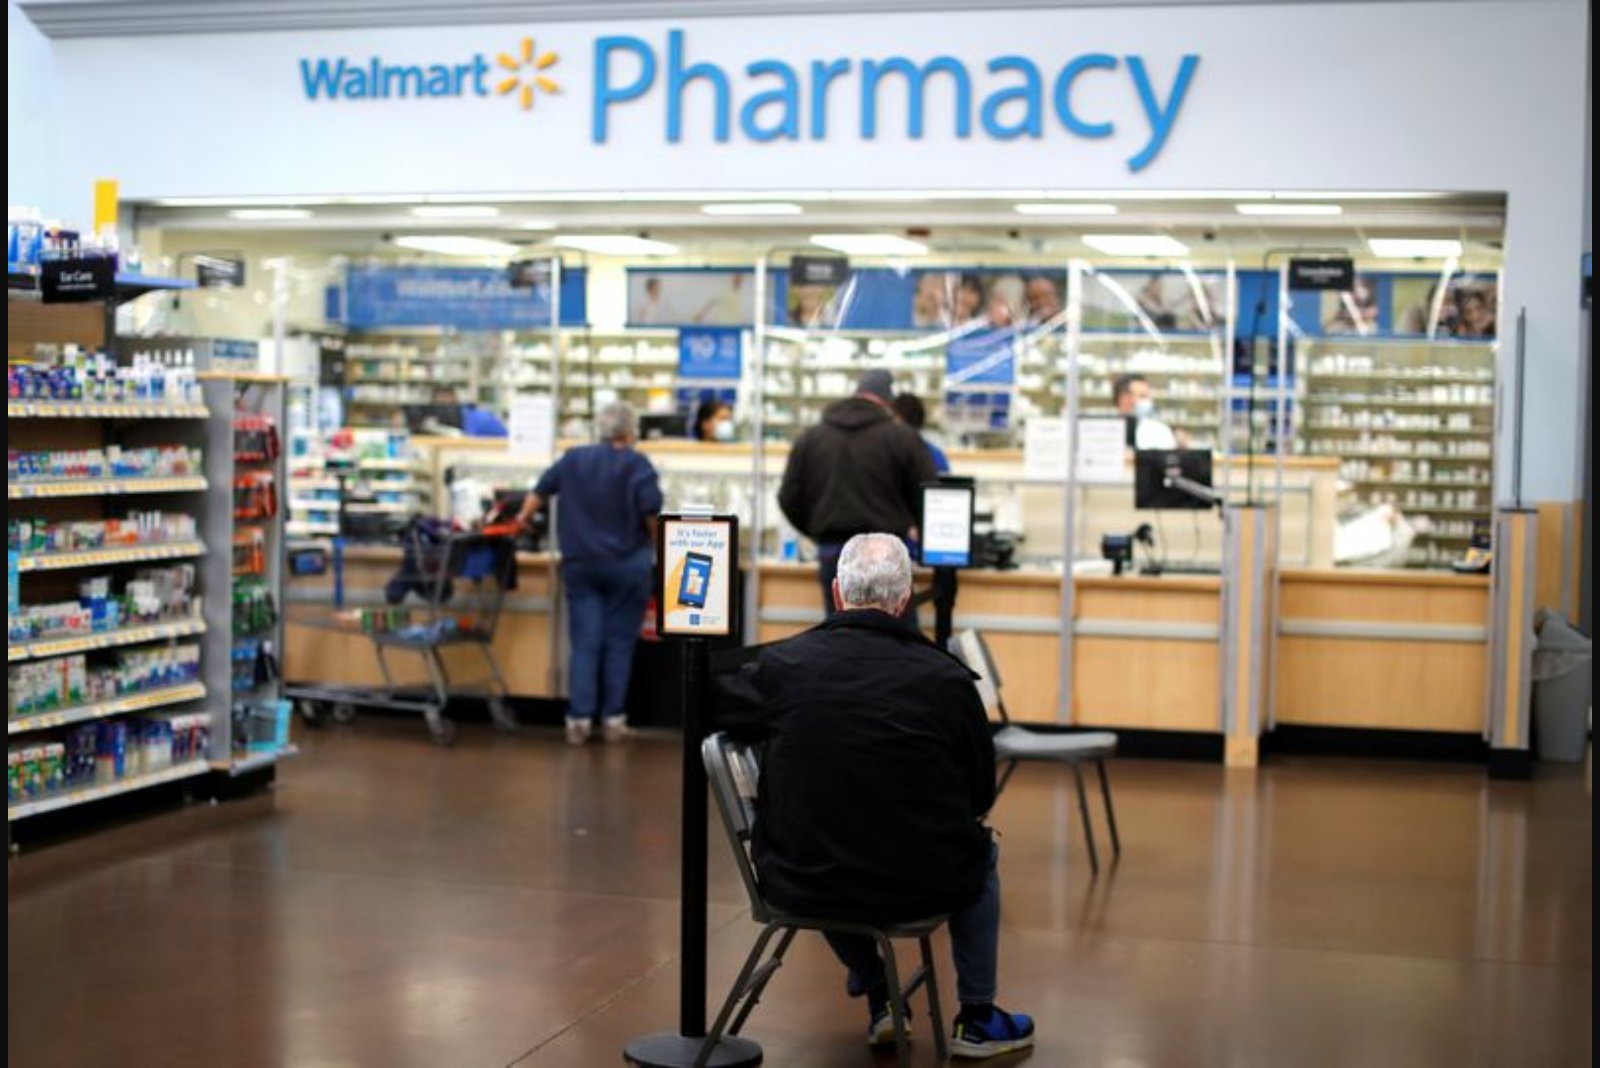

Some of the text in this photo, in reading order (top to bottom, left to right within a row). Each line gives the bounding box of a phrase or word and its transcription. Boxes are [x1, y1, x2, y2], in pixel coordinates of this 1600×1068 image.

[299, 29, 1199, 172] Walmart Pharmacy
[693, 529, 717, 537] faster
[670, 539, 688, 547] with
[707, 540, 724, 549] App
